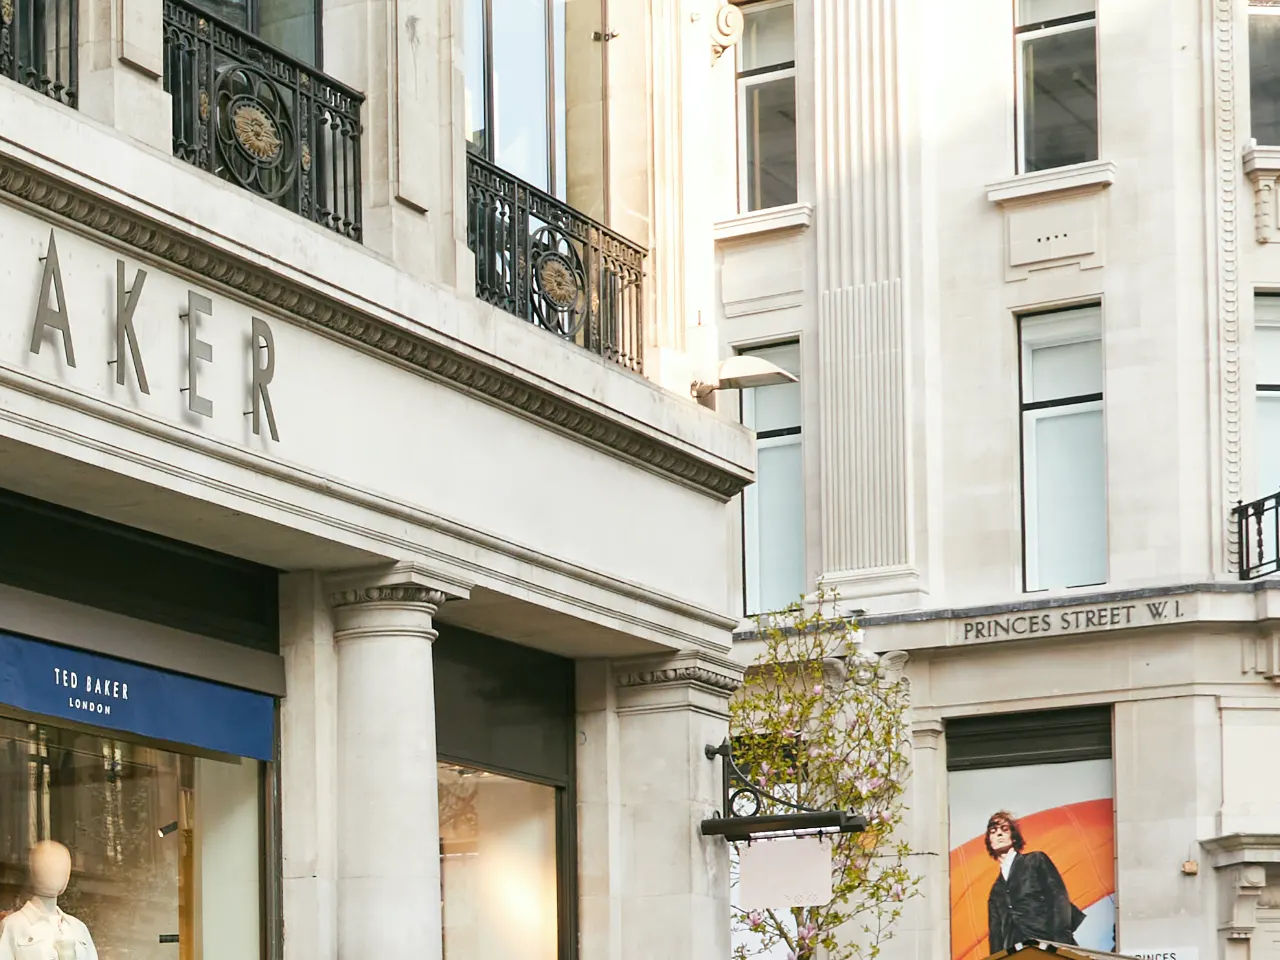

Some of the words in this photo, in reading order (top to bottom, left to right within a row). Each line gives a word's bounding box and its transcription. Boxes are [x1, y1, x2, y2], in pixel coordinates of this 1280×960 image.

[963, 614, 1051, 640] PRINCES
[1060, 605, 1135, 630] STREET
[54, 667, 78, 689] TED
[86, 675, 128, 700] BAKER
[69, 697, 111, 715] LONDON
